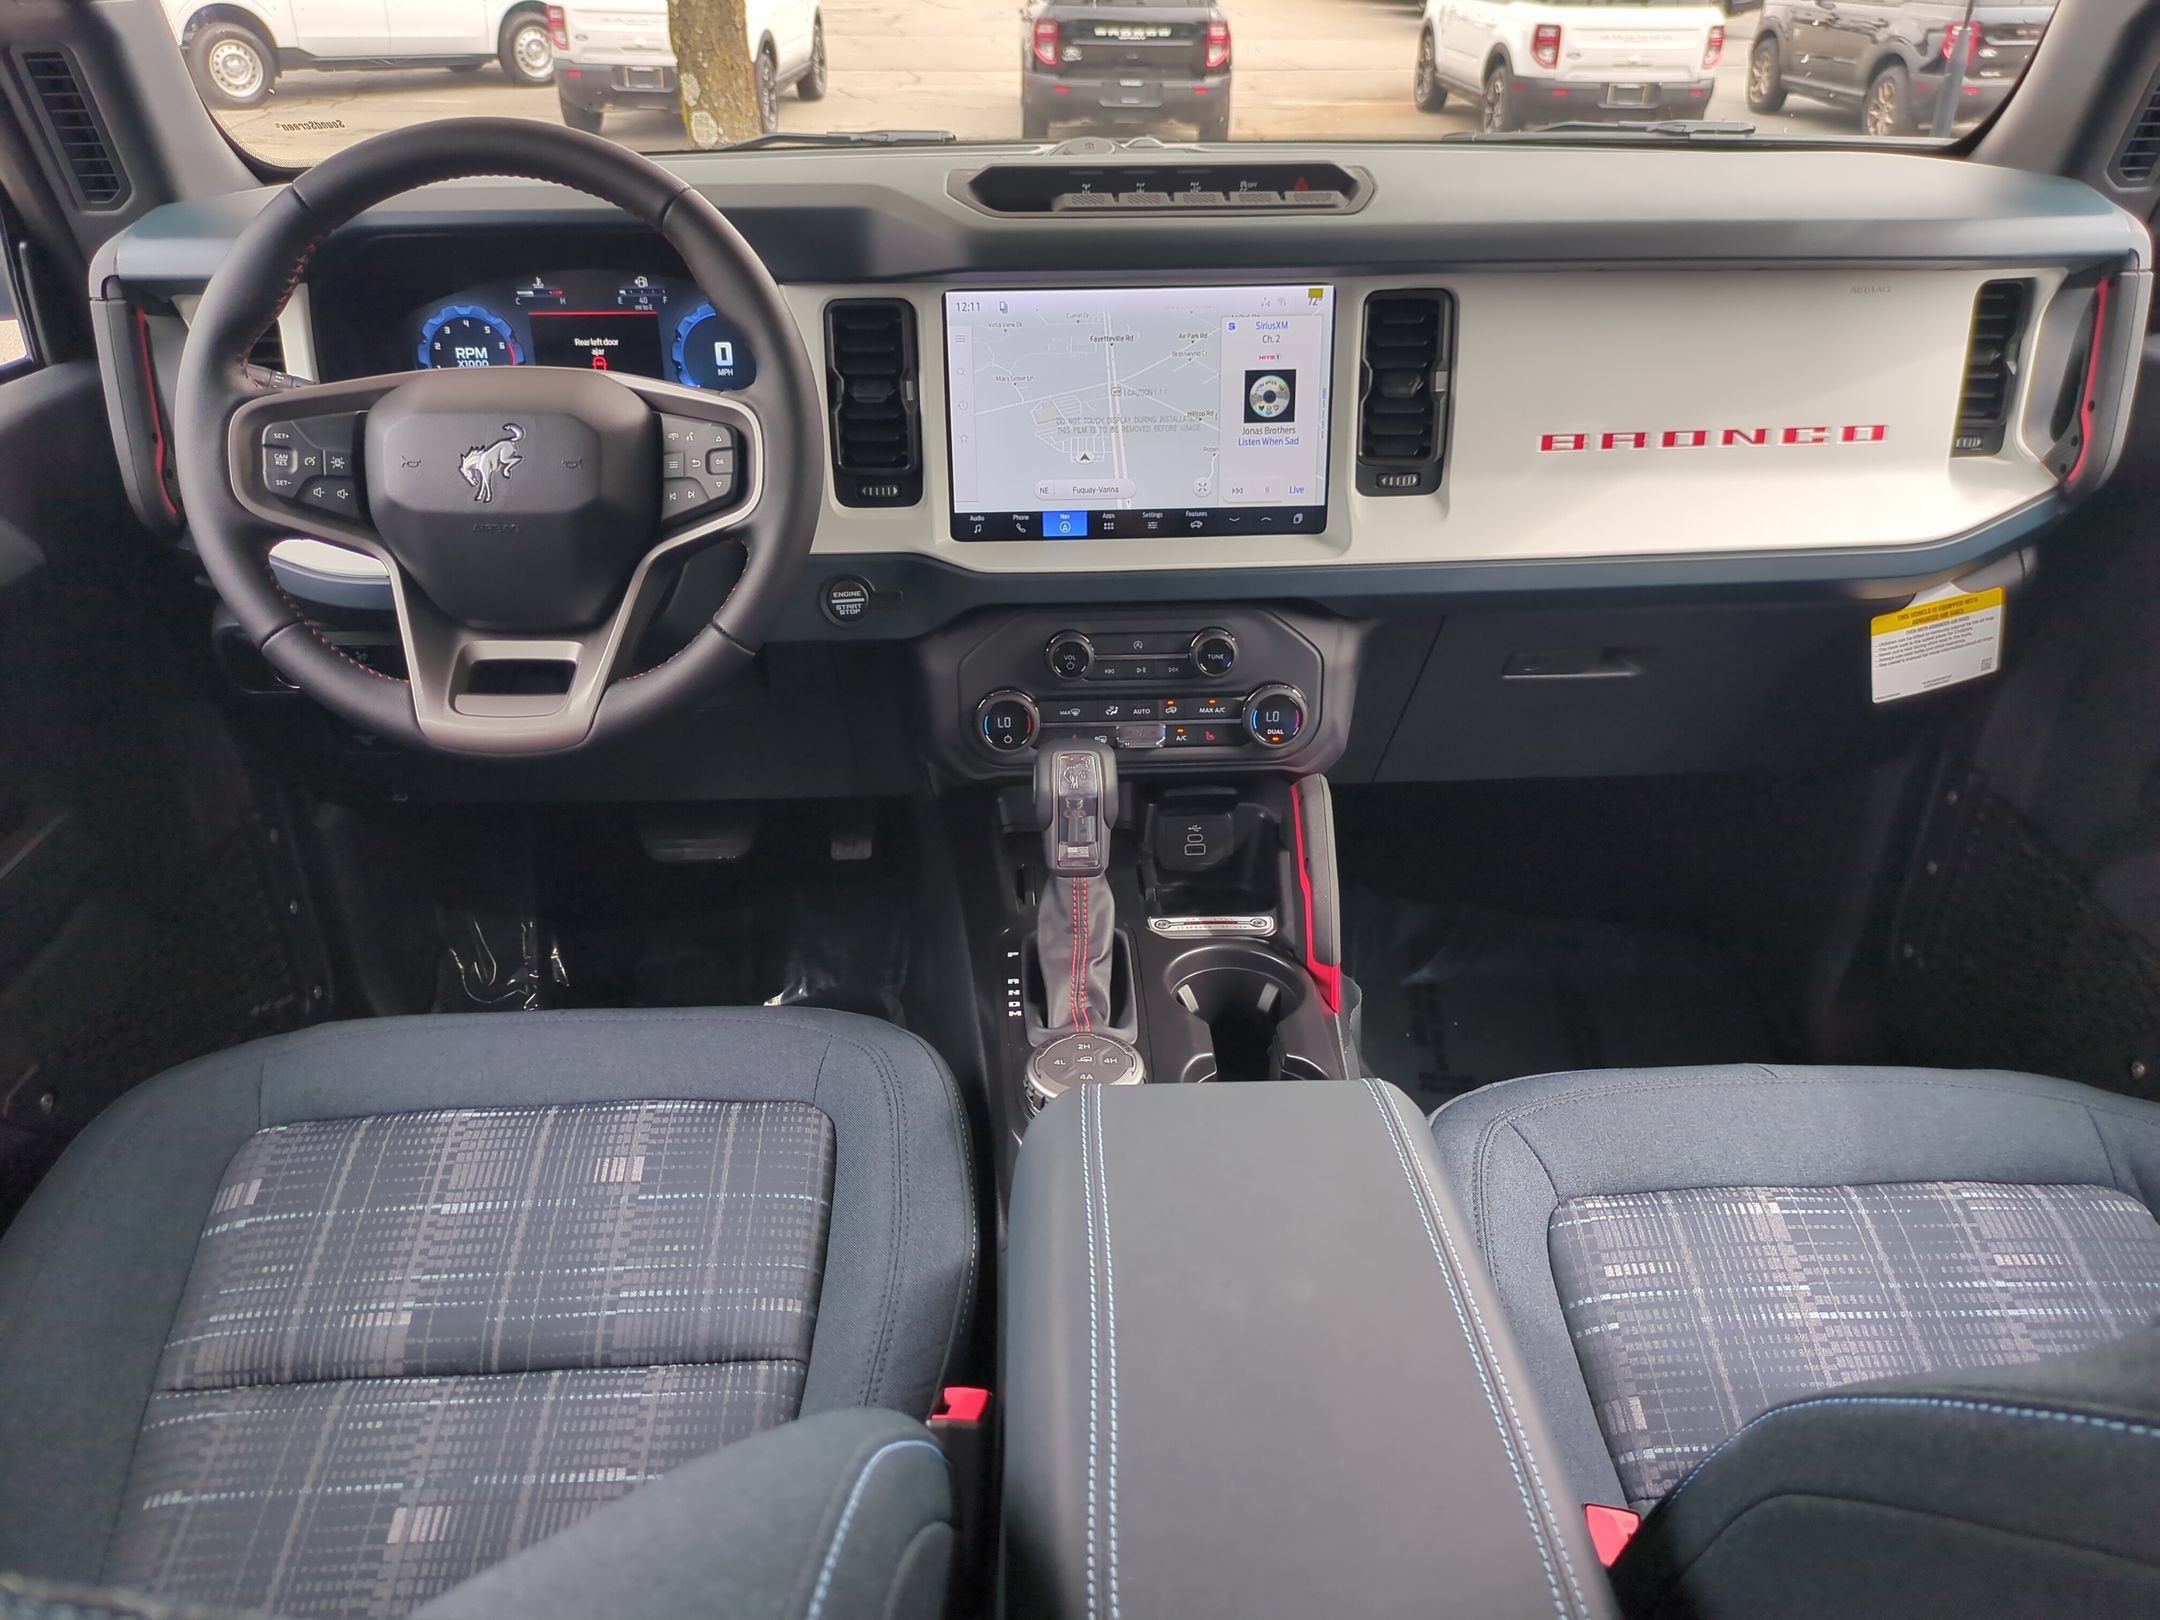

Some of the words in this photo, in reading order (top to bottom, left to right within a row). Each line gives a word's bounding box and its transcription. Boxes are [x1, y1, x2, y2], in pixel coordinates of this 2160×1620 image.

[560, 297, 566, 305] H
[956, 301, 981, 312] 12:11
[463, 319, 470, 327] 4
[1256, 321, 1288, 331] SiriusXM
[444, 326, 451, 334] 3
[484, 326, 491, 334] 5
[574, 338, 589, 346] Rear
[590, 338, 602, 346] left
[603, 338, 619, 346] door
[1089, 335, 1125, 343] Fayetteville
[1126, 334, 1134, 342] Rd
[1262, 335, 1275, 343] Ch.
[1275, 335, 1281, 343] 2
[434, 342, 441, 350] 2
[499, 342, 505, 350] 6
[455, 347, 488, 359] RPM
[592, 348, 605, 356] ajar
[714, 341, 734, 366] 0
[717, 368, 734, 376] MPH
[1242, 427, 1263, 435] Jonas
[1264, 426, 1296, 435] Brothers
[1238, 438, 1260, 446] Listen
[1262, 437, 1284, 446] When
[1285, 436, 1299, 445] Sad
[1536, 424, 1890, 452] BRONCO
[1072, 486, 1119, 495] Fuquay-Varina
[1289, 485, 1305, 494] Live
[1102, 512, 1116, 520] Apps
[1142, 512, 1163, 520] Settings
[833, 590, 861, 598] ENGINE
[1266, 711, 1279, 722] LO
[997, 717, 1011, 728] LO
